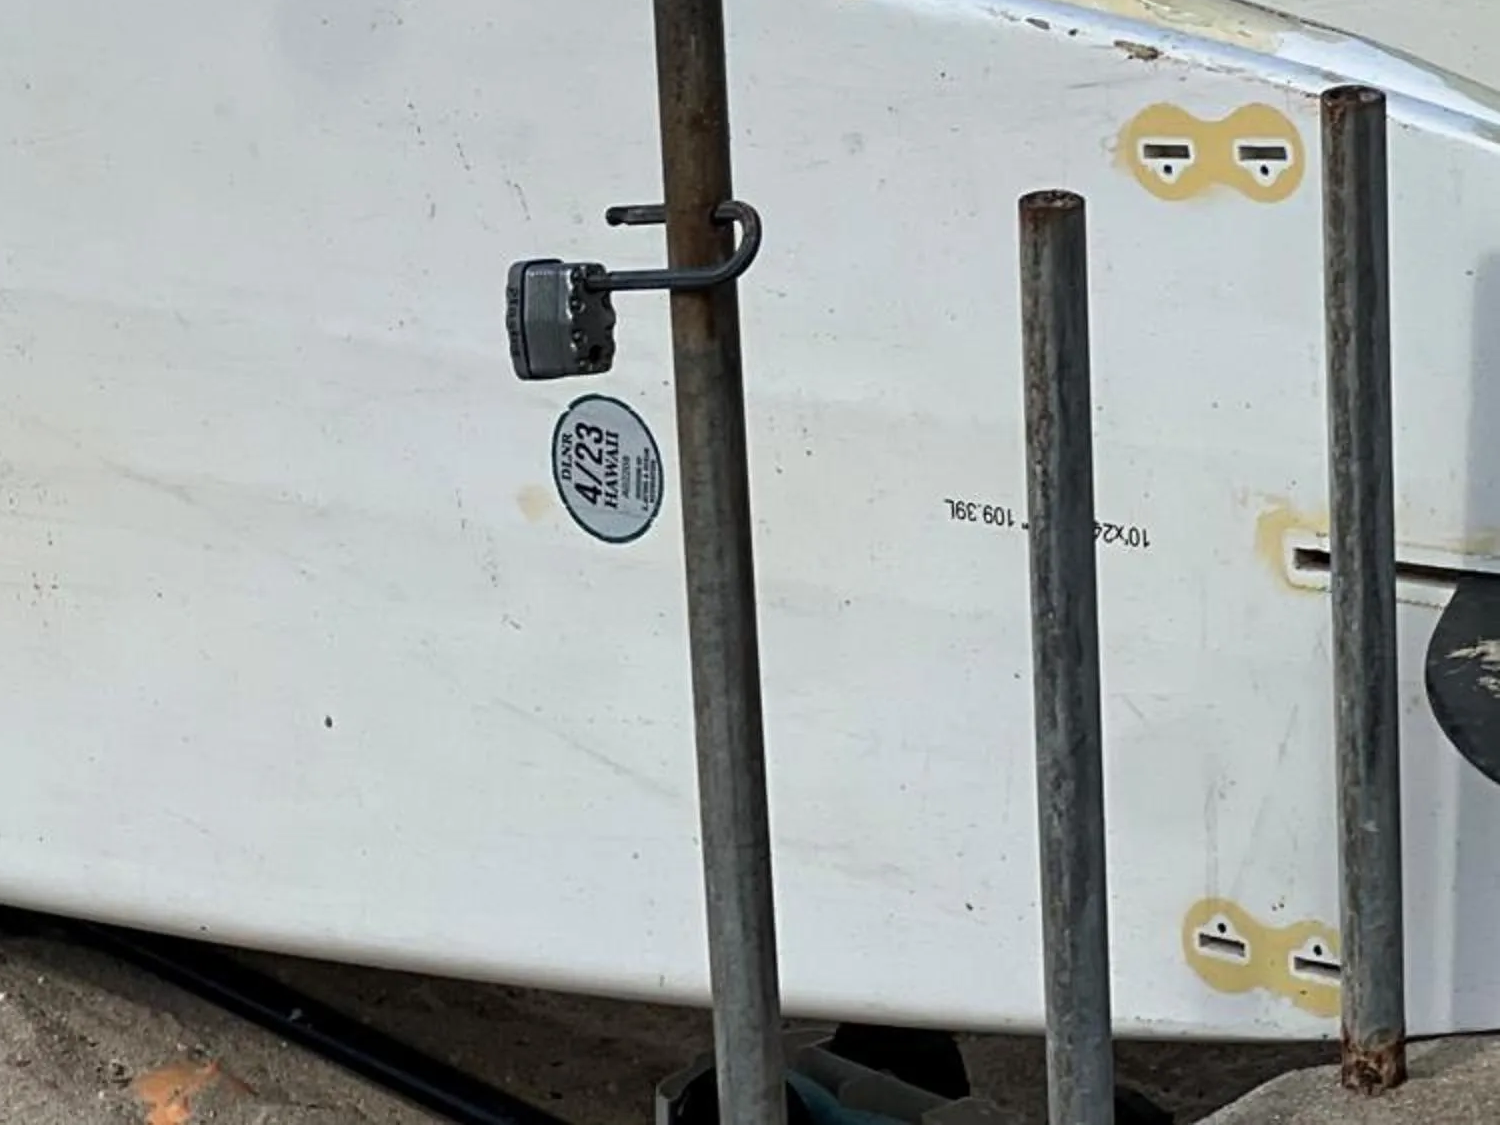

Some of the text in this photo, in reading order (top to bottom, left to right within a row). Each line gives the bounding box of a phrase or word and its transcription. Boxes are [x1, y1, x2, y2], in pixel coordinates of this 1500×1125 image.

[561, 432, 573, 481] DLNR
[574, 422, 603, 505] 4/23
[604, 430, 619, 509] HAWAII
[944, 498, 1015, 527] 109.39L
